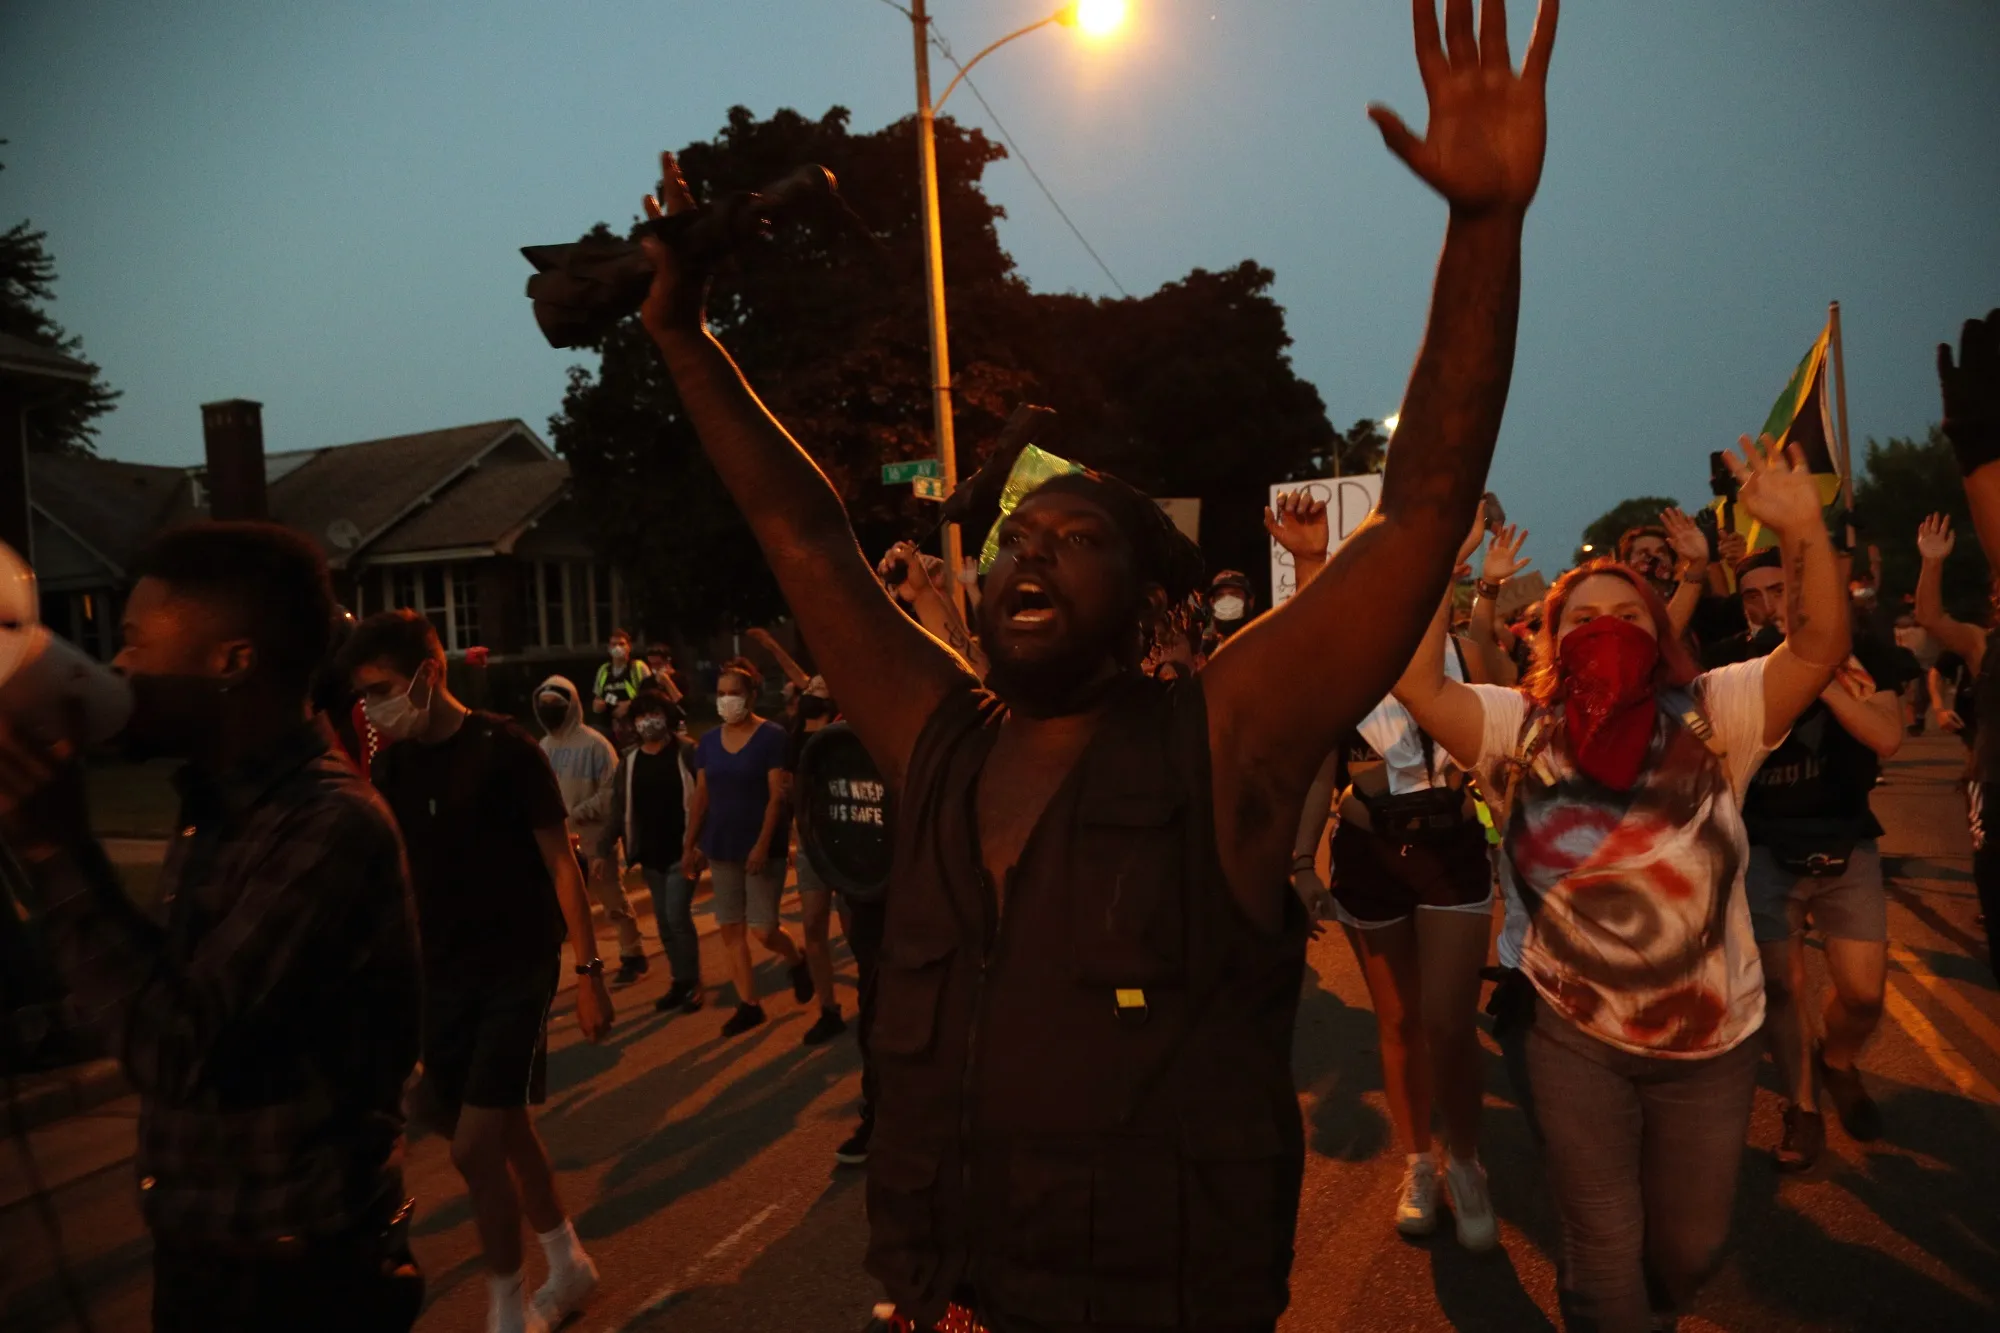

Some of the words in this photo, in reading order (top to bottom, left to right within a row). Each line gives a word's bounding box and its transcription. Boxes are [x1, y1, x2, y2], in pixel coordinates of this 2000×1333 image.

[849, 780, 885, 803] KEEP
[828, 804, 848, 823] US
[850, 805, 885, 828] SAFE
